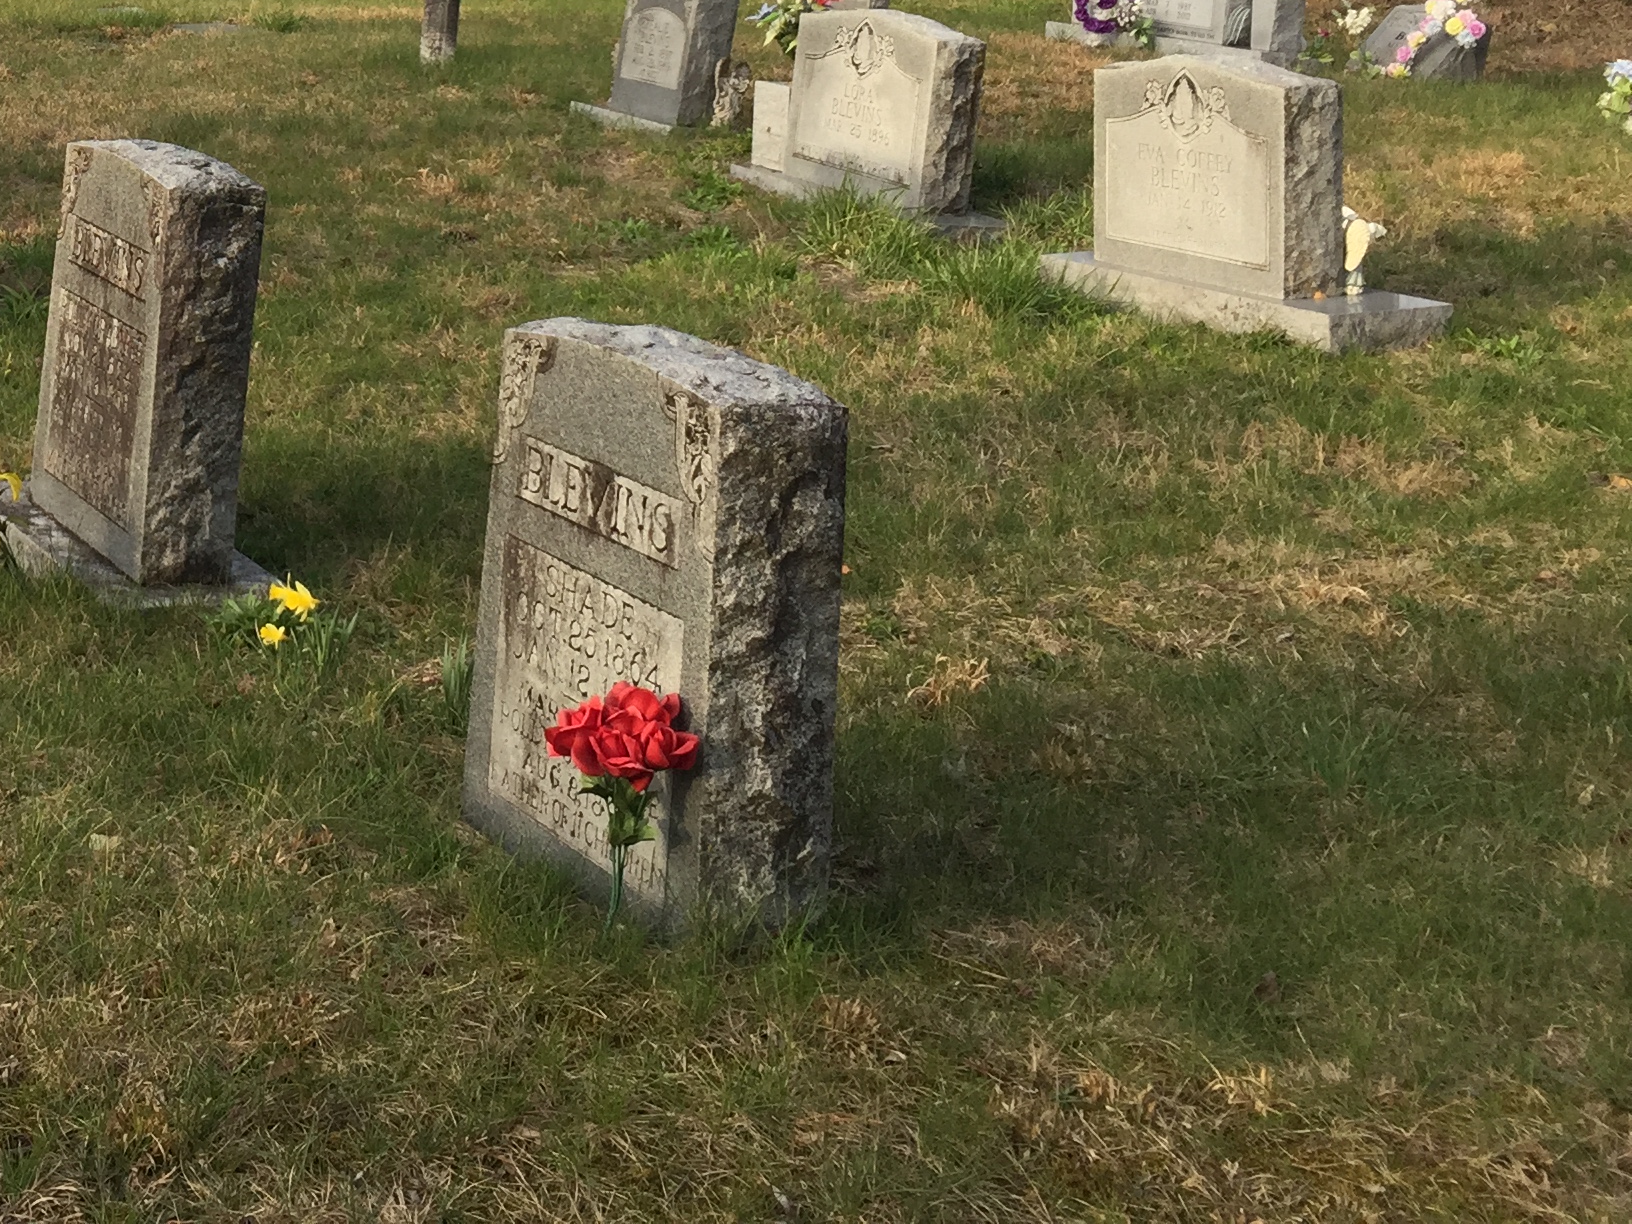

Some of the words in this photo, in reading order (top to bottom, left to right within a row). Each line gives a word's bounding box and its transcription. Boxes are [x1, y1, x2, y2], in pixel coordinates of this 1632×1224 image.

[831, 97, 883, 127] BLEVINS
[844, 83, 875, 104] LORA
[1137, 142, 1166, 164] EVA
[1175, 148, 1233, 174] COFFEY
[1151, 166, 1220, 197] BLEVINS
[72, 223, 146, 293] BLEVINS
[522, 445, 670, 553] BLEVINS
[547, 564, 635, 641] SHADE
[488, 759, 550, 817] FATHER
[551, 798, 568, 829] OF
